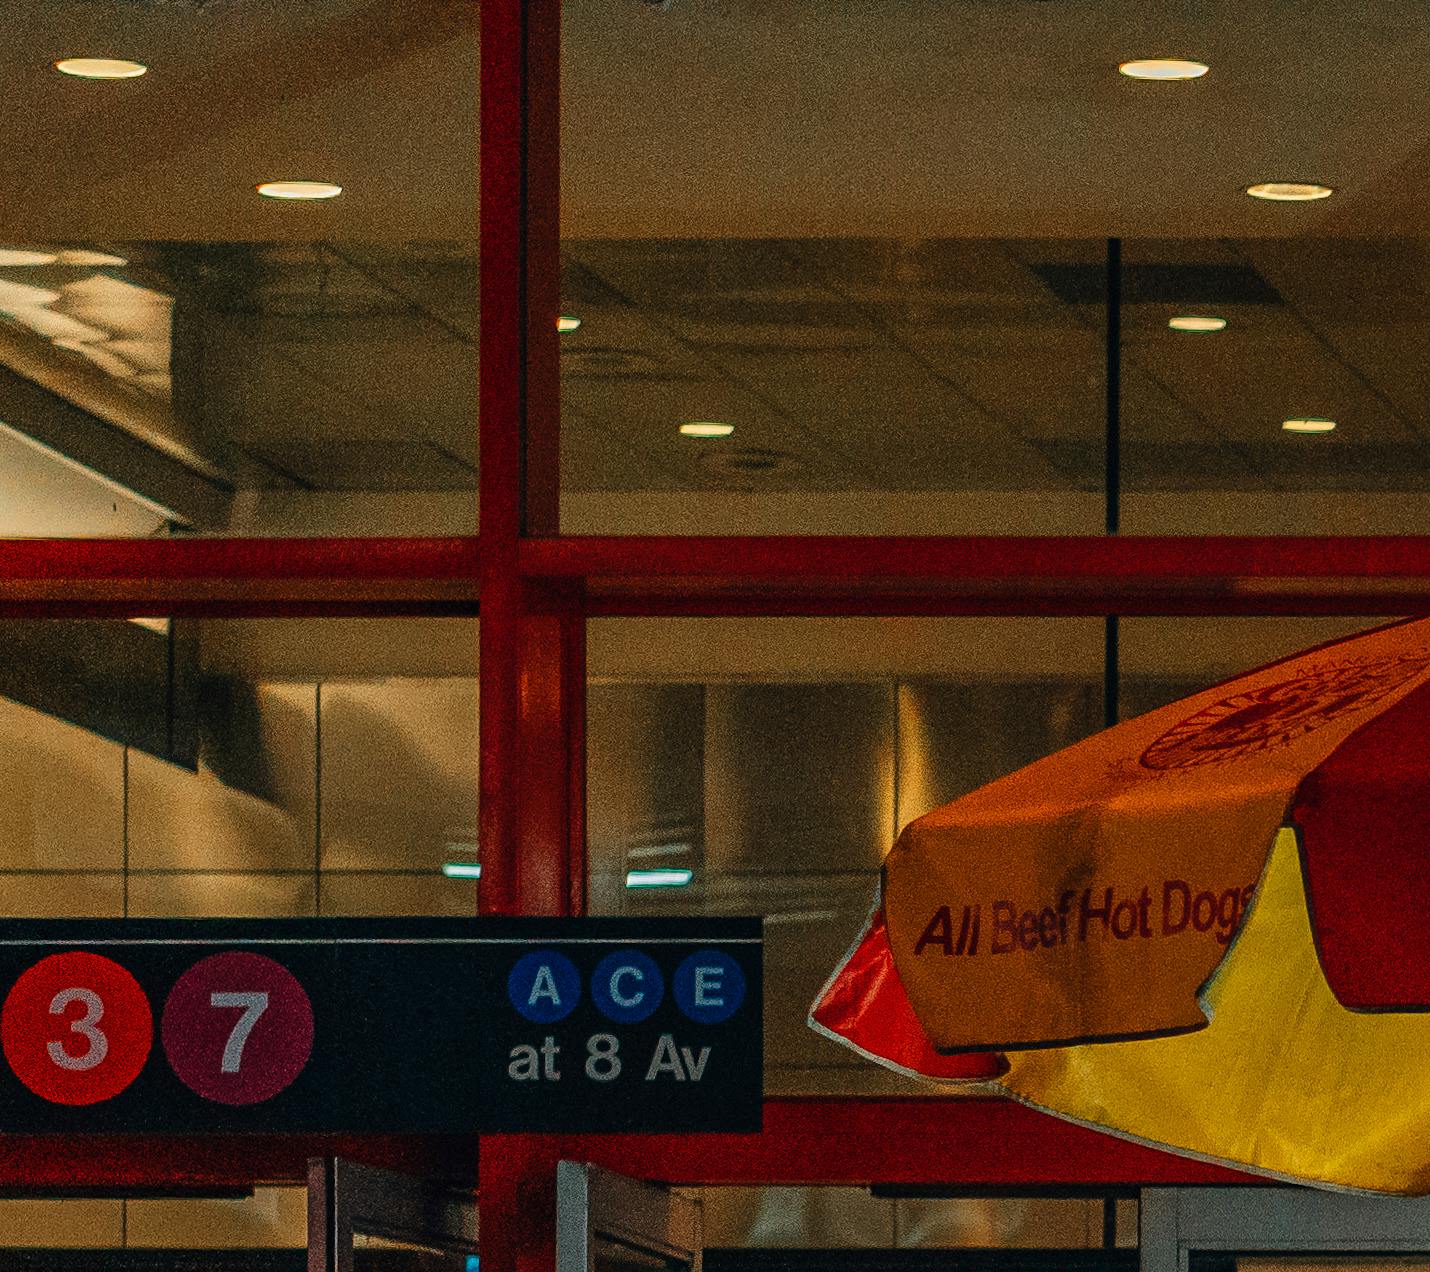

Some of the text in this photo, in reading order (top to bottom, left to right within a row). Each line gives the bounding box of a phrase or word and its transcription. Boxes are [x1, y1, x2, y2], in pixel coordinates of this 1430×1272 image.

[914, 905, 982, 956] All
[991, 890, 1072, 955] Beef
[1078, 887, 1154, 944] Hot
[527, 966, 725, 1008] A C E
[46, 988, 269, 1074] 3 7
[507, 1034, 712, 1082] at 8 Av
